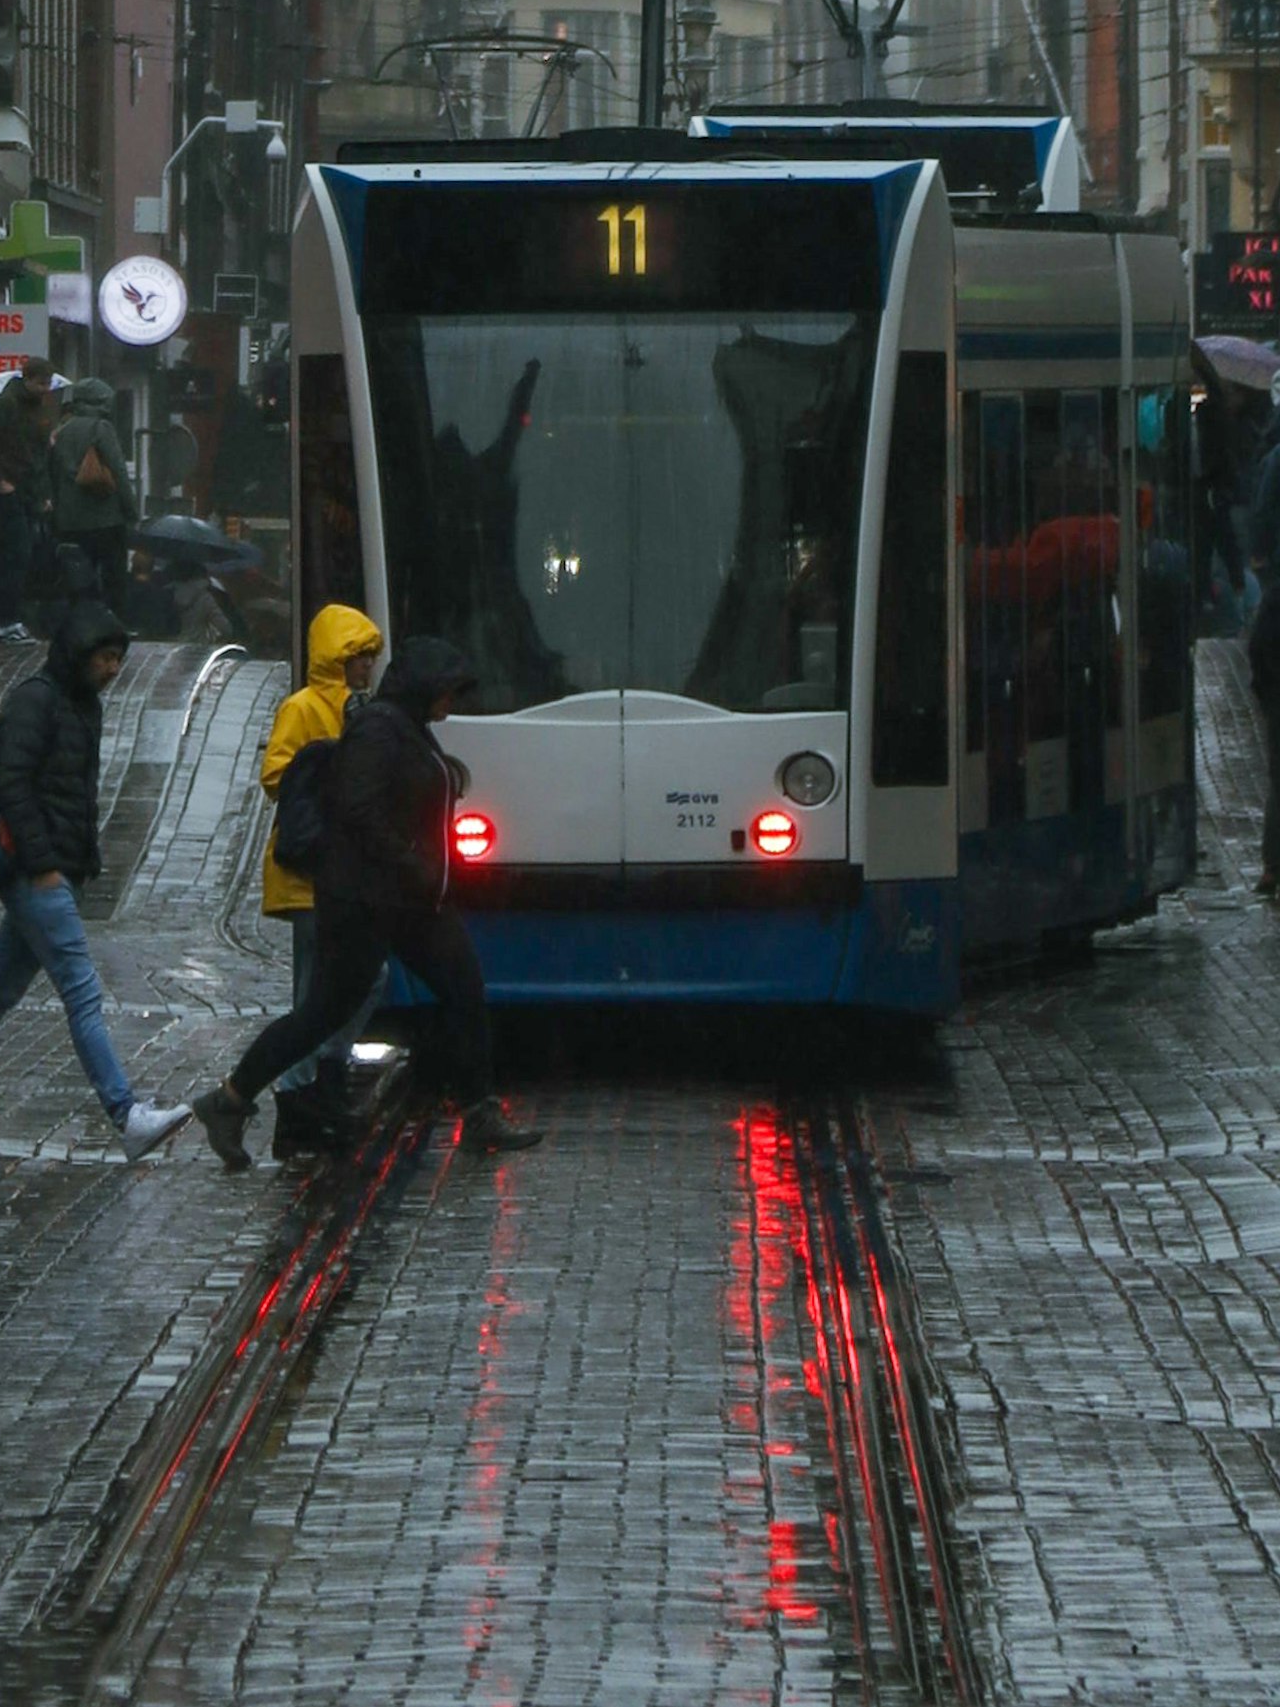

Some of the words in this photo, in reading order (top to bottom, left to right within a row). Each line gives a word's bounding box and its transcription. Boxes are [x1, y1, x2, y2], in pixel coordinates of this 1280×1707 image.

[595, 202, 648, 277] 11
[691, 793, 719, 805] GVB
[677, 814, 716, 828] 2112
